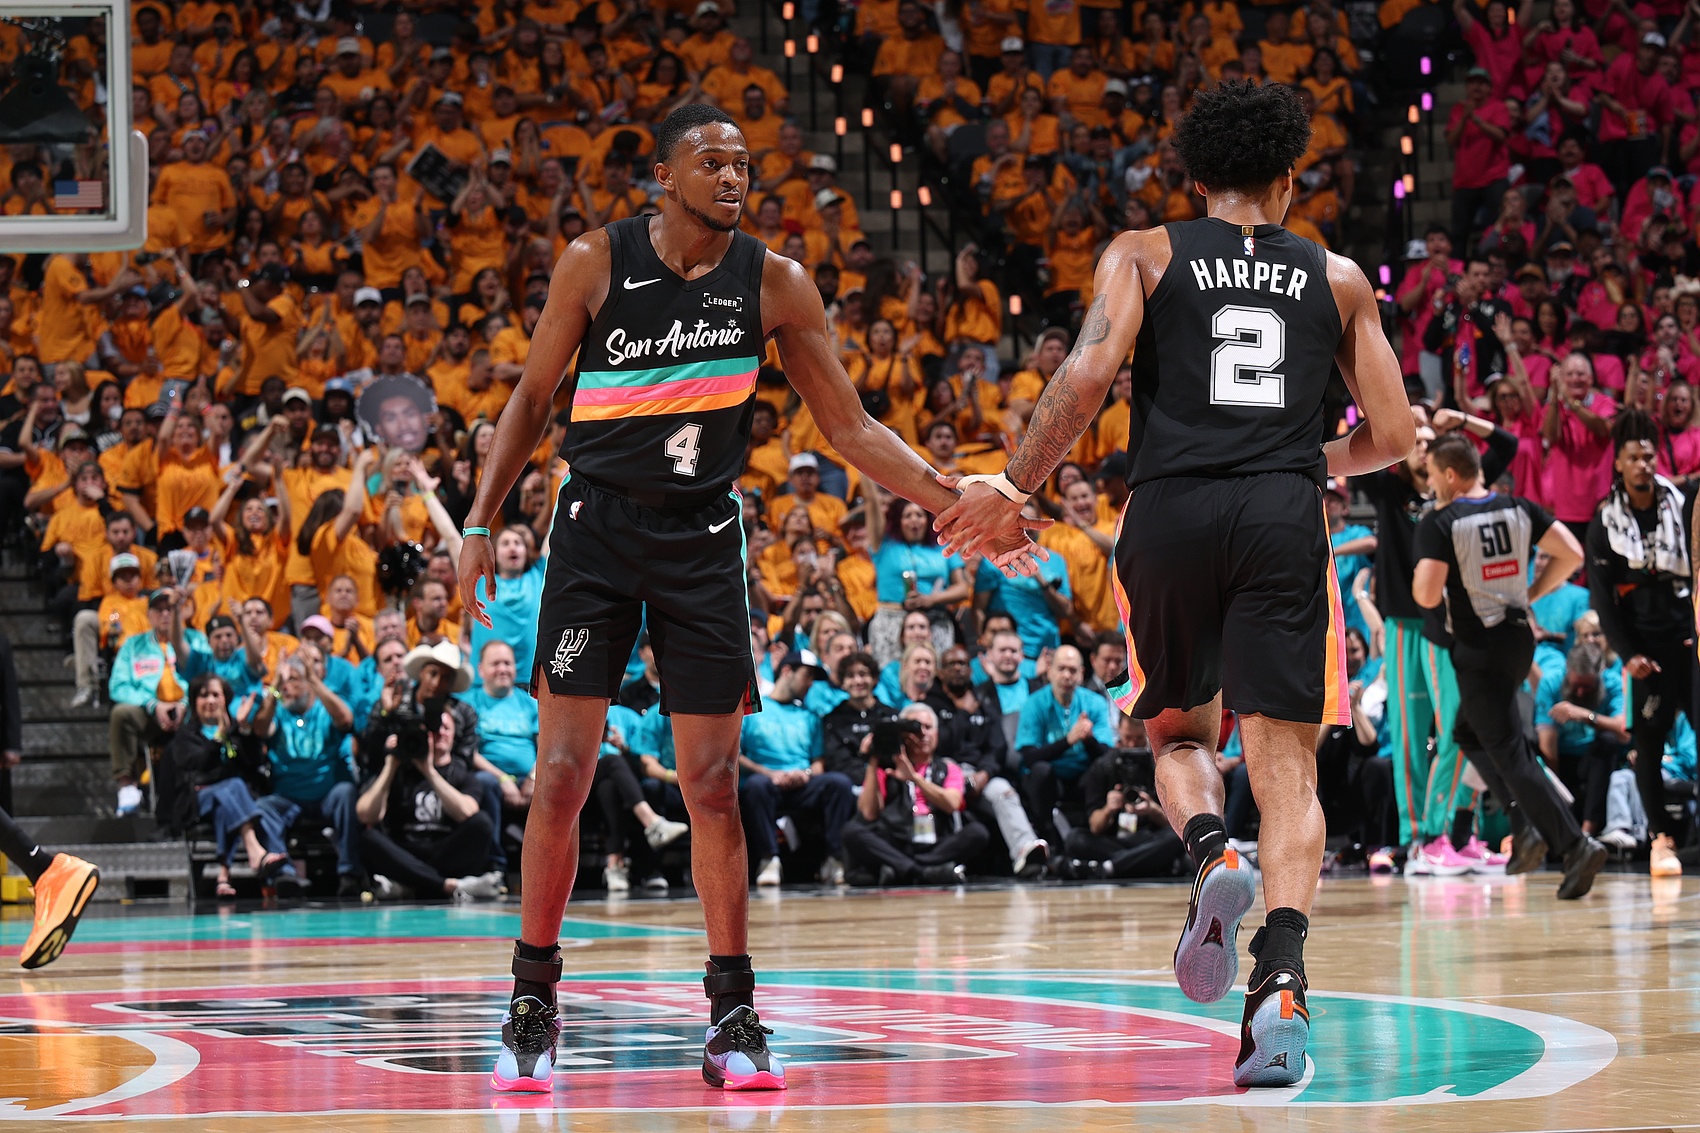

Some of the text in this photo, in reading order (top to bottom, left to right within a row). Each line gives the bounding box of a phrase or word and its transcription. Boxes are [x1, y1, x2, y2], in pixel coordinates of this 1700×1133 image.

[708, 297, 738, 308] LEDGER
[1189, 258, 1308, 301] HARPER
[605, 318, 745, 366] San Antonio
[1209, 303, 1286, 409] 2
[664, 422, 703, 477] 4
[1478, 521, 1512, 558] 50
[757, 1003, 1213, 1052] ANTONIO
